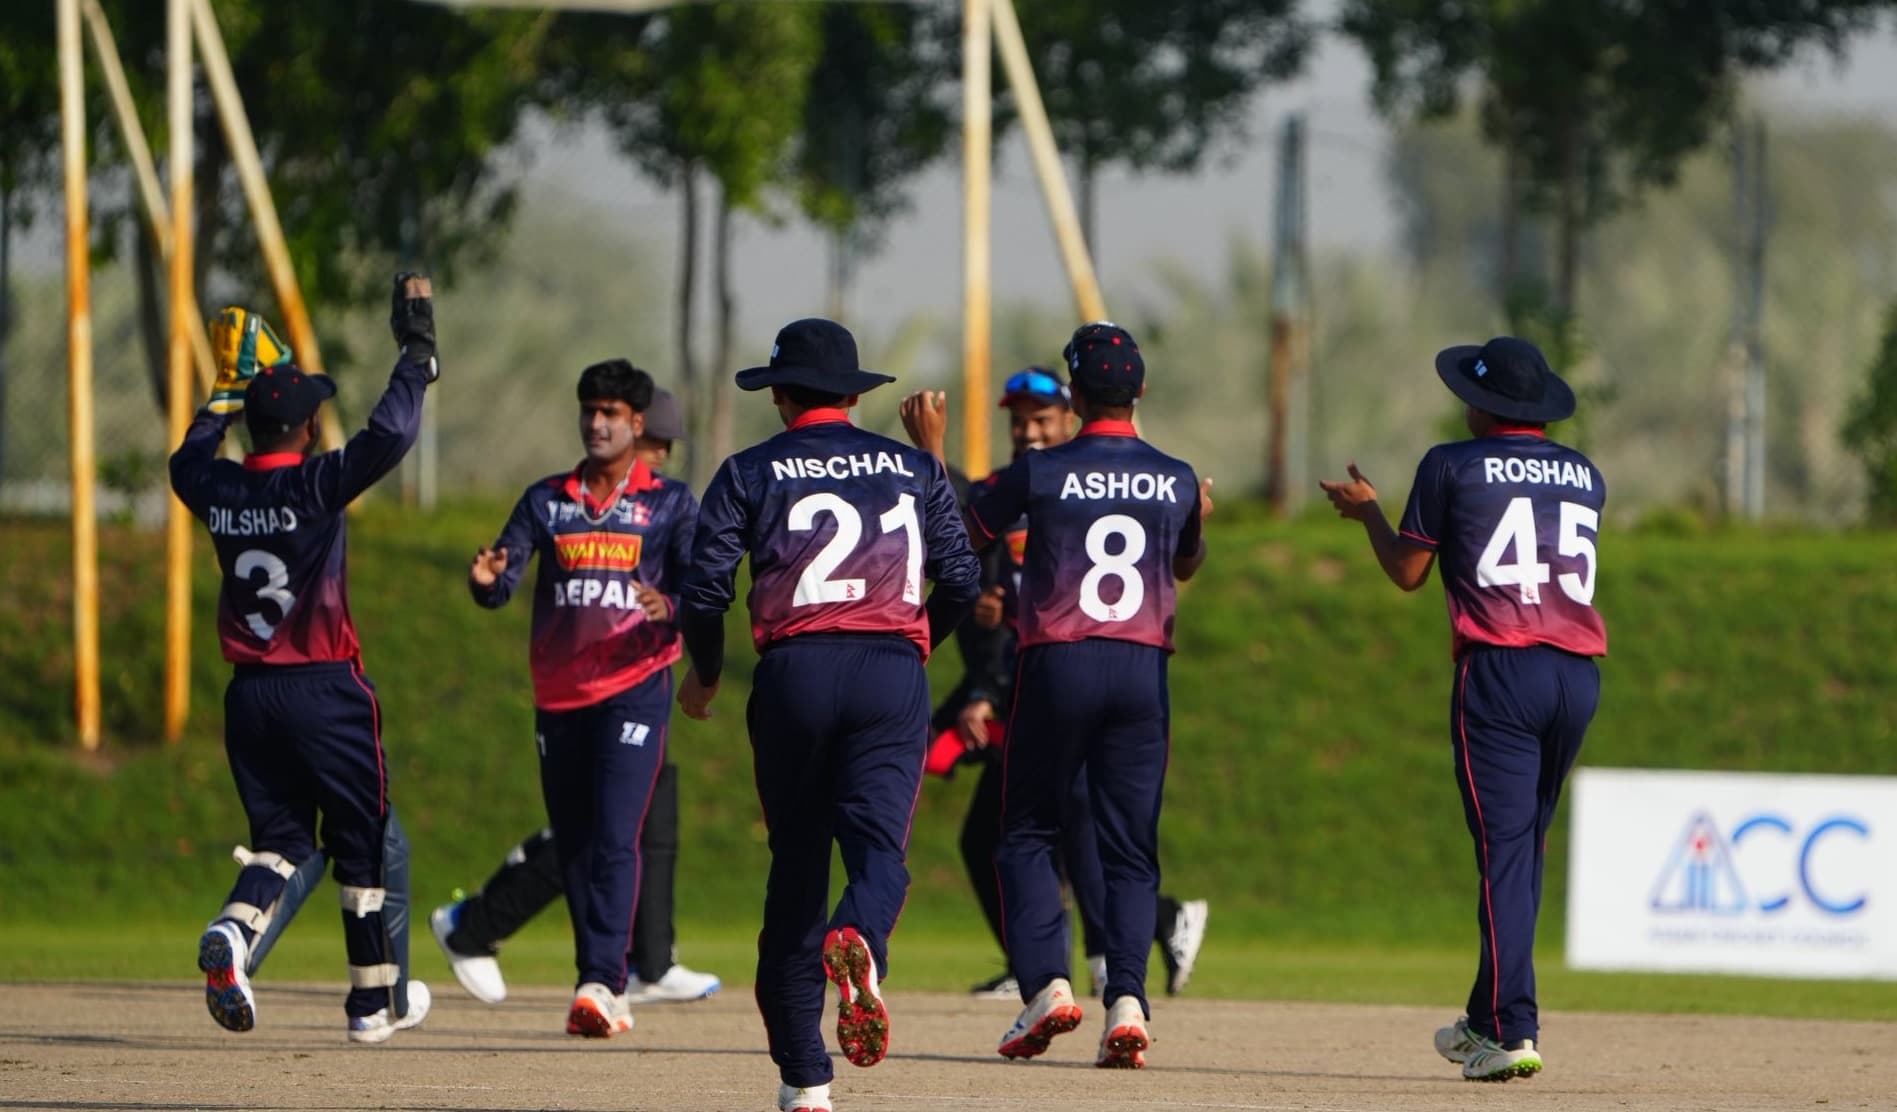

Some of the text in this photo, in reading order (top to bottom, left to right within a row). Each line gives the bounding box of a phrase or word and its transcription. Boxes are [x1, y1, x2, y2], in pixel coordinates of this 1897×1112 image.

[771, 451, 914, 481] NISCHAL
[1484, 457, 1593, 491] ROSHAN
[1059, 472, 1178, 503] ASHOK
[208, 506, 297, 536] DILSHAD
[561, 541, 635, 561] WAI WAI
[787, 492, 923, 608] 21
[1476, 497, 1599, 606] 45
[1079, 513, 1147, 622] 8
[235, 549, 296, 641] 3
